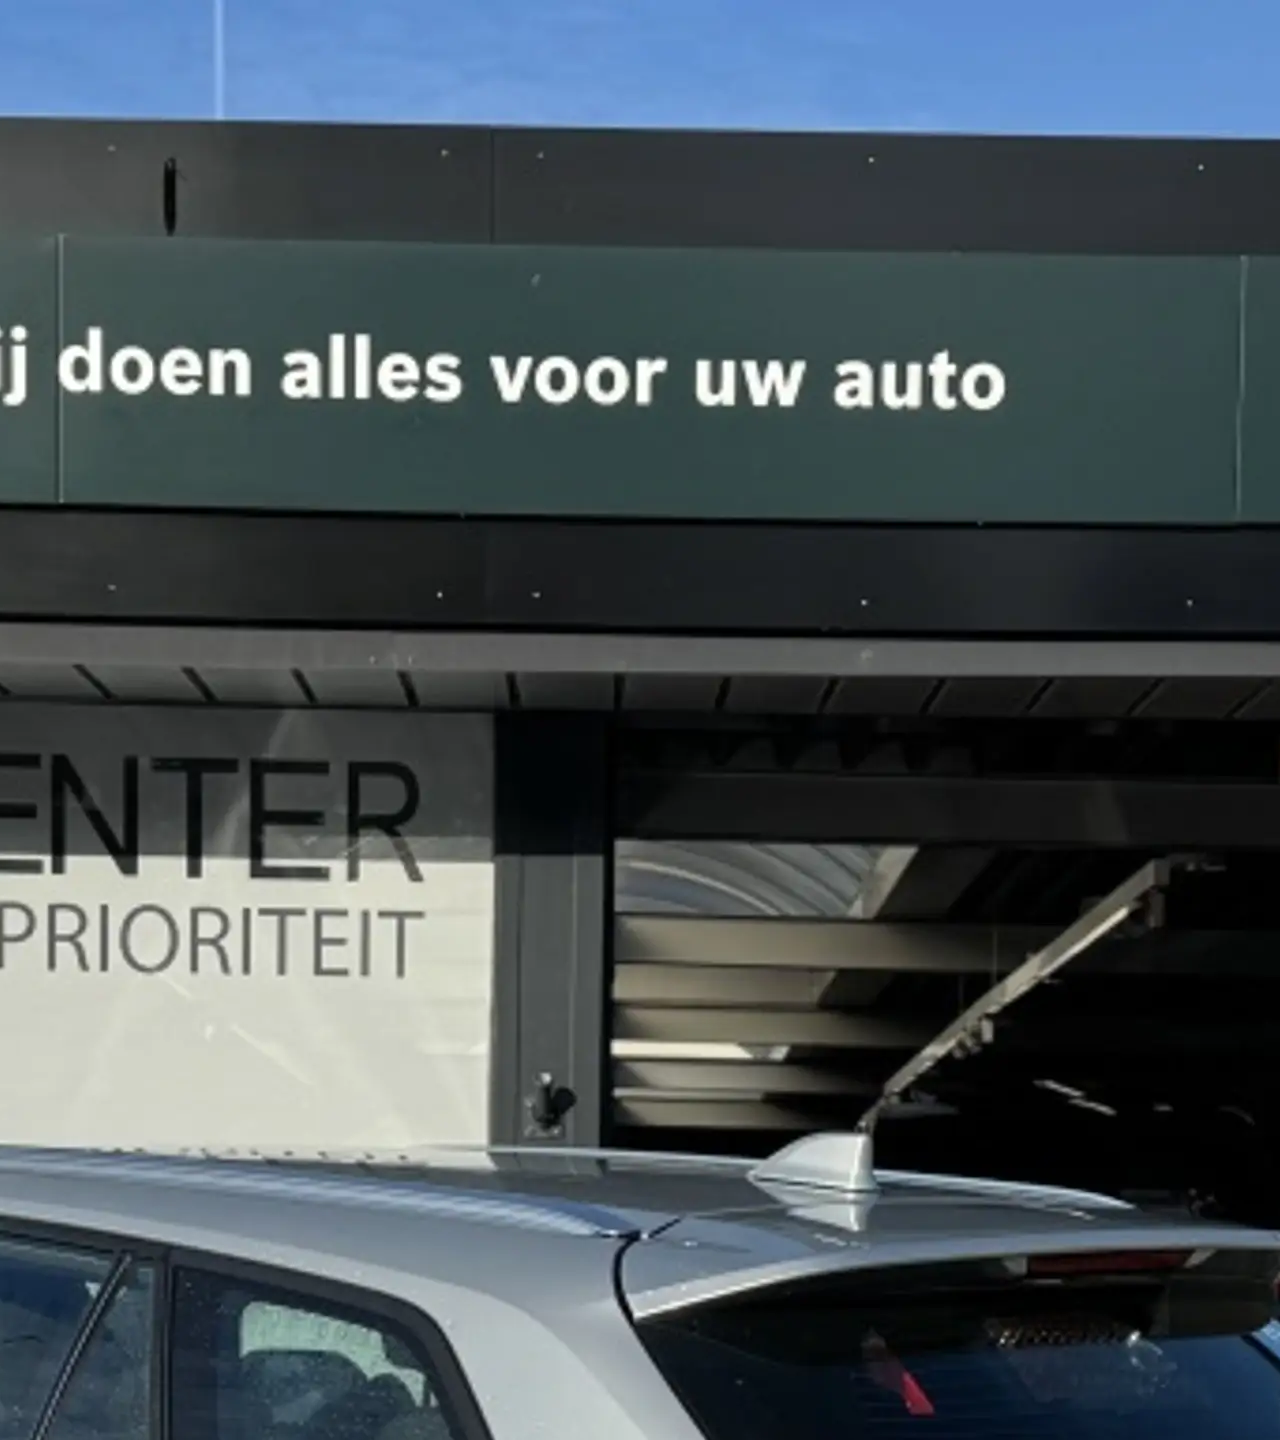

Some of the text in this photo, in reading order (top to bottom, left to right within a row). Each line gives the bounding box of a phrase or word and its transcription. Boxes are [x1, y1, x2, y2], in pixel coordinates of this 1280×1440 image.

[58, 326, 252, 396] doen
[280, 333, 464, 402] alles
[489, 355, 668, 405] voor
[694, 358, 807, 407] uw
[833, 348, 1007, 411] auto
